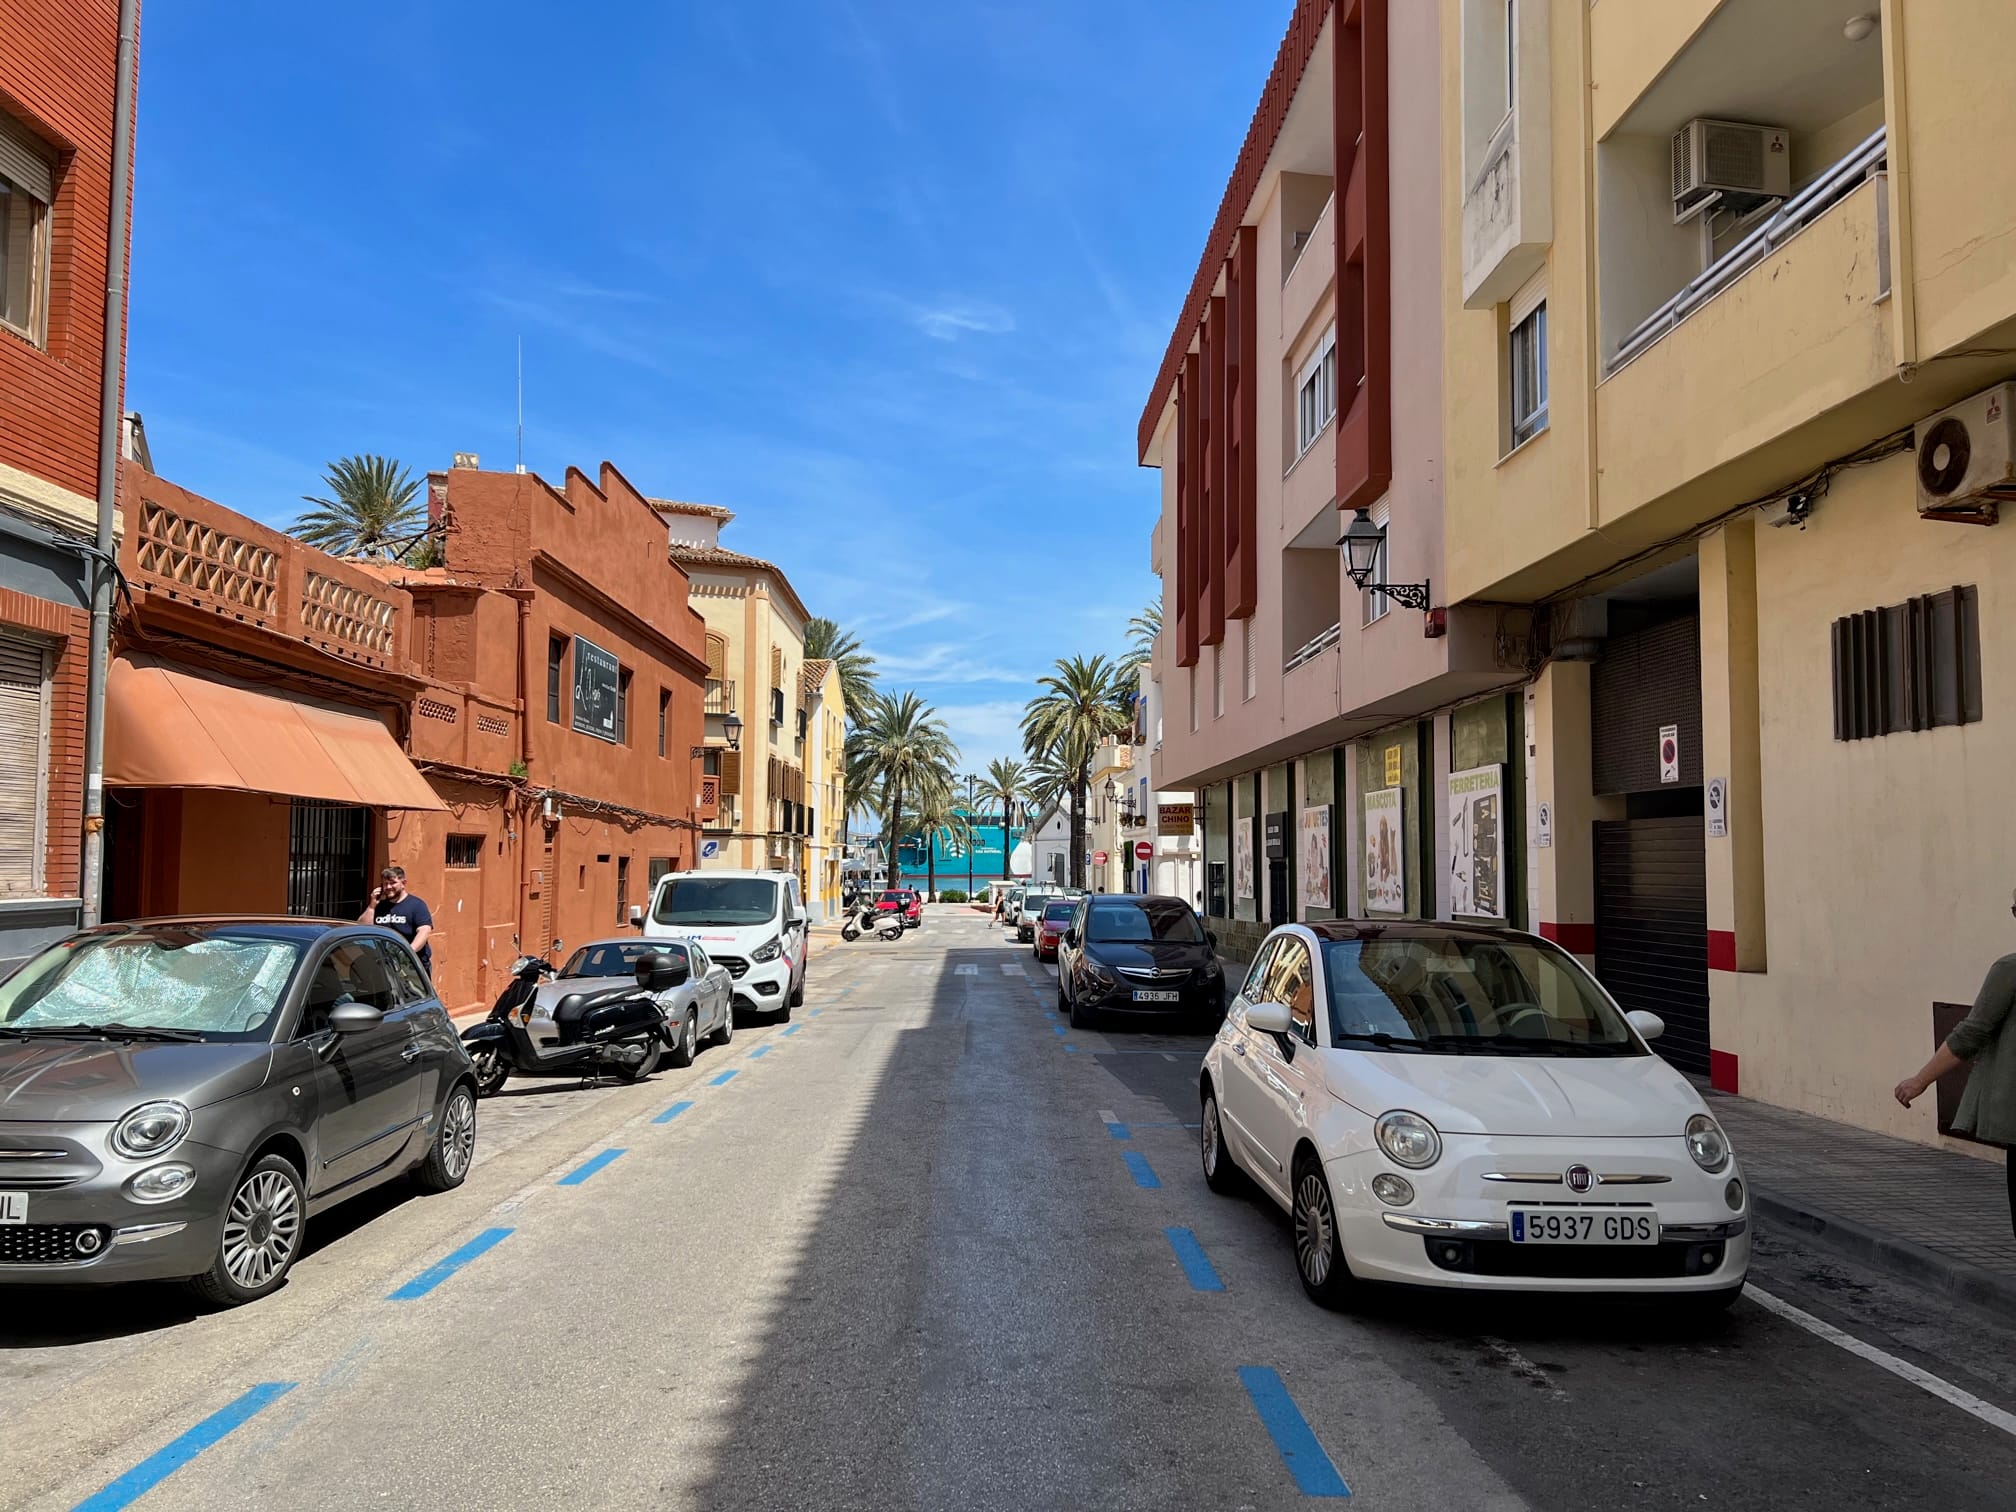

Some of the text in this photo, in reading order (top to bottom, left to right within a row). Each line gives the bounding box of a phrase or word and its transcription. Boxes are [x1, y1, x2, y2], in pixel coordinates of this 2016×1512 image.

[1159, 806, 1191, 814] BAZAR
[1161, 815, 1190, 823] CHINO
[375, 913, 406, 924] adidas
[1163, 991, 1178, 1001] JFH
[1572, 1172, 1587, 1185] FIAT
[1529, 1215, 1594, 1240] 5937
[1604, 1216, 1650, 1240] GDS
